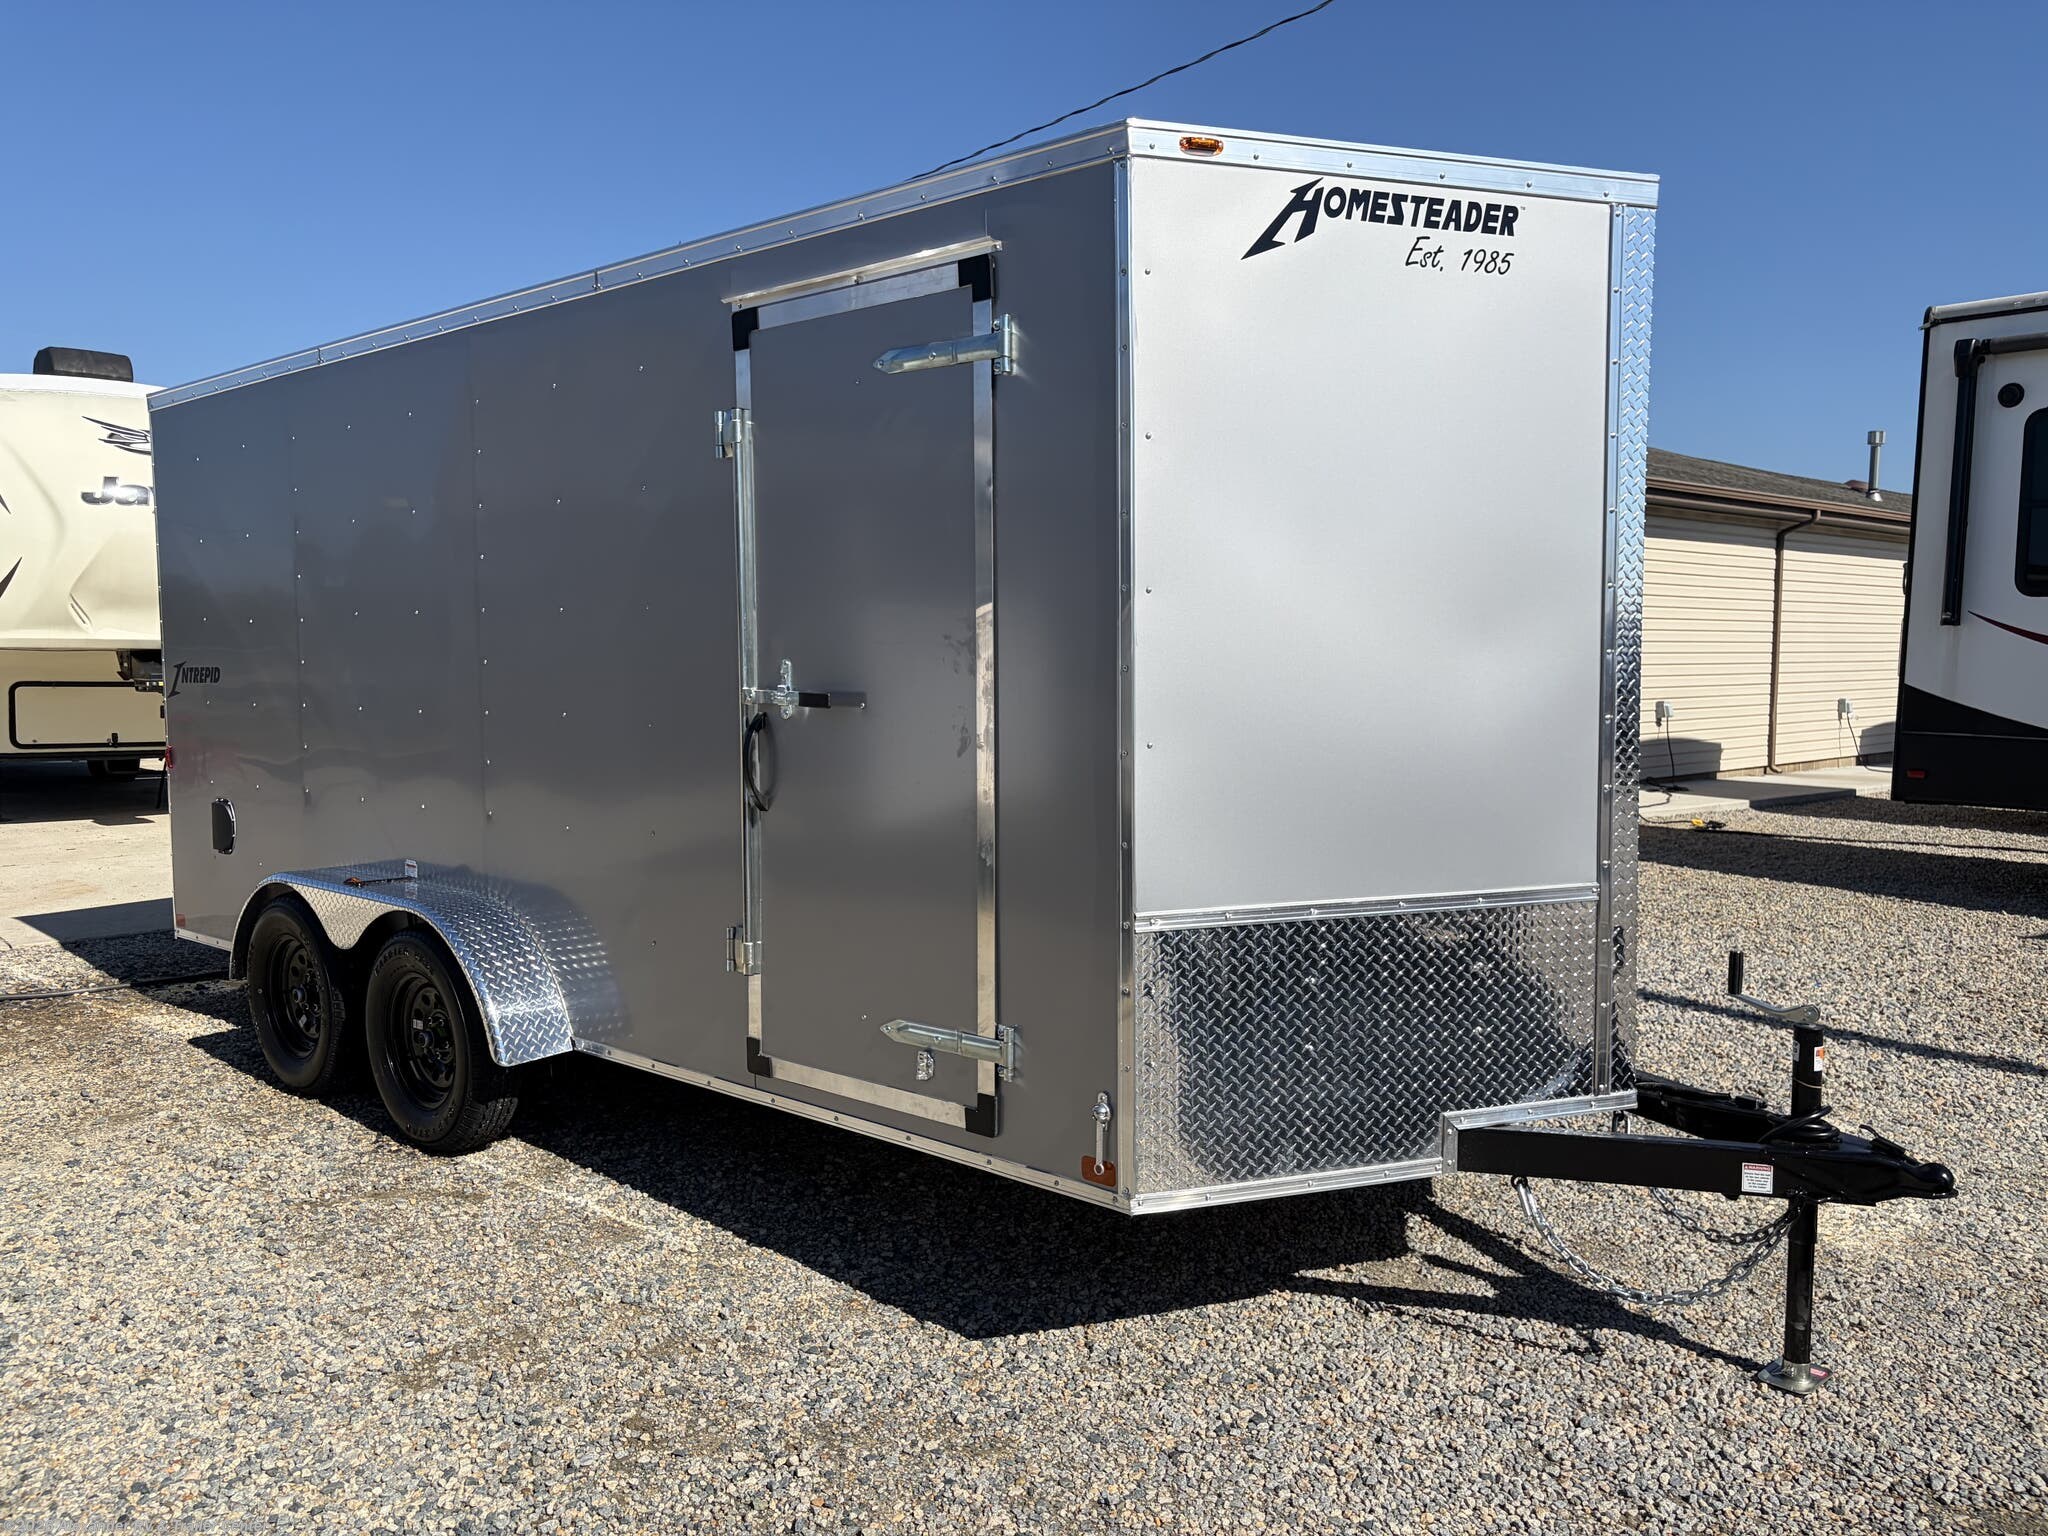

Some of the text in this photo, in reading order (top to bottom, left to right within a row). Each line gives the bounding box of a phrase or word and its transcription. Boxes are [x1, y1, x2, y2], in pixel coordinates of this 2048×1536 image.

[1241, 177, 1519, 260] HOMESTEADER
[1405, 236, 1515, 275] Est. 1985
[81, 476, 154, 506] Ja
[168, 661, 221, 698] INTREPID
